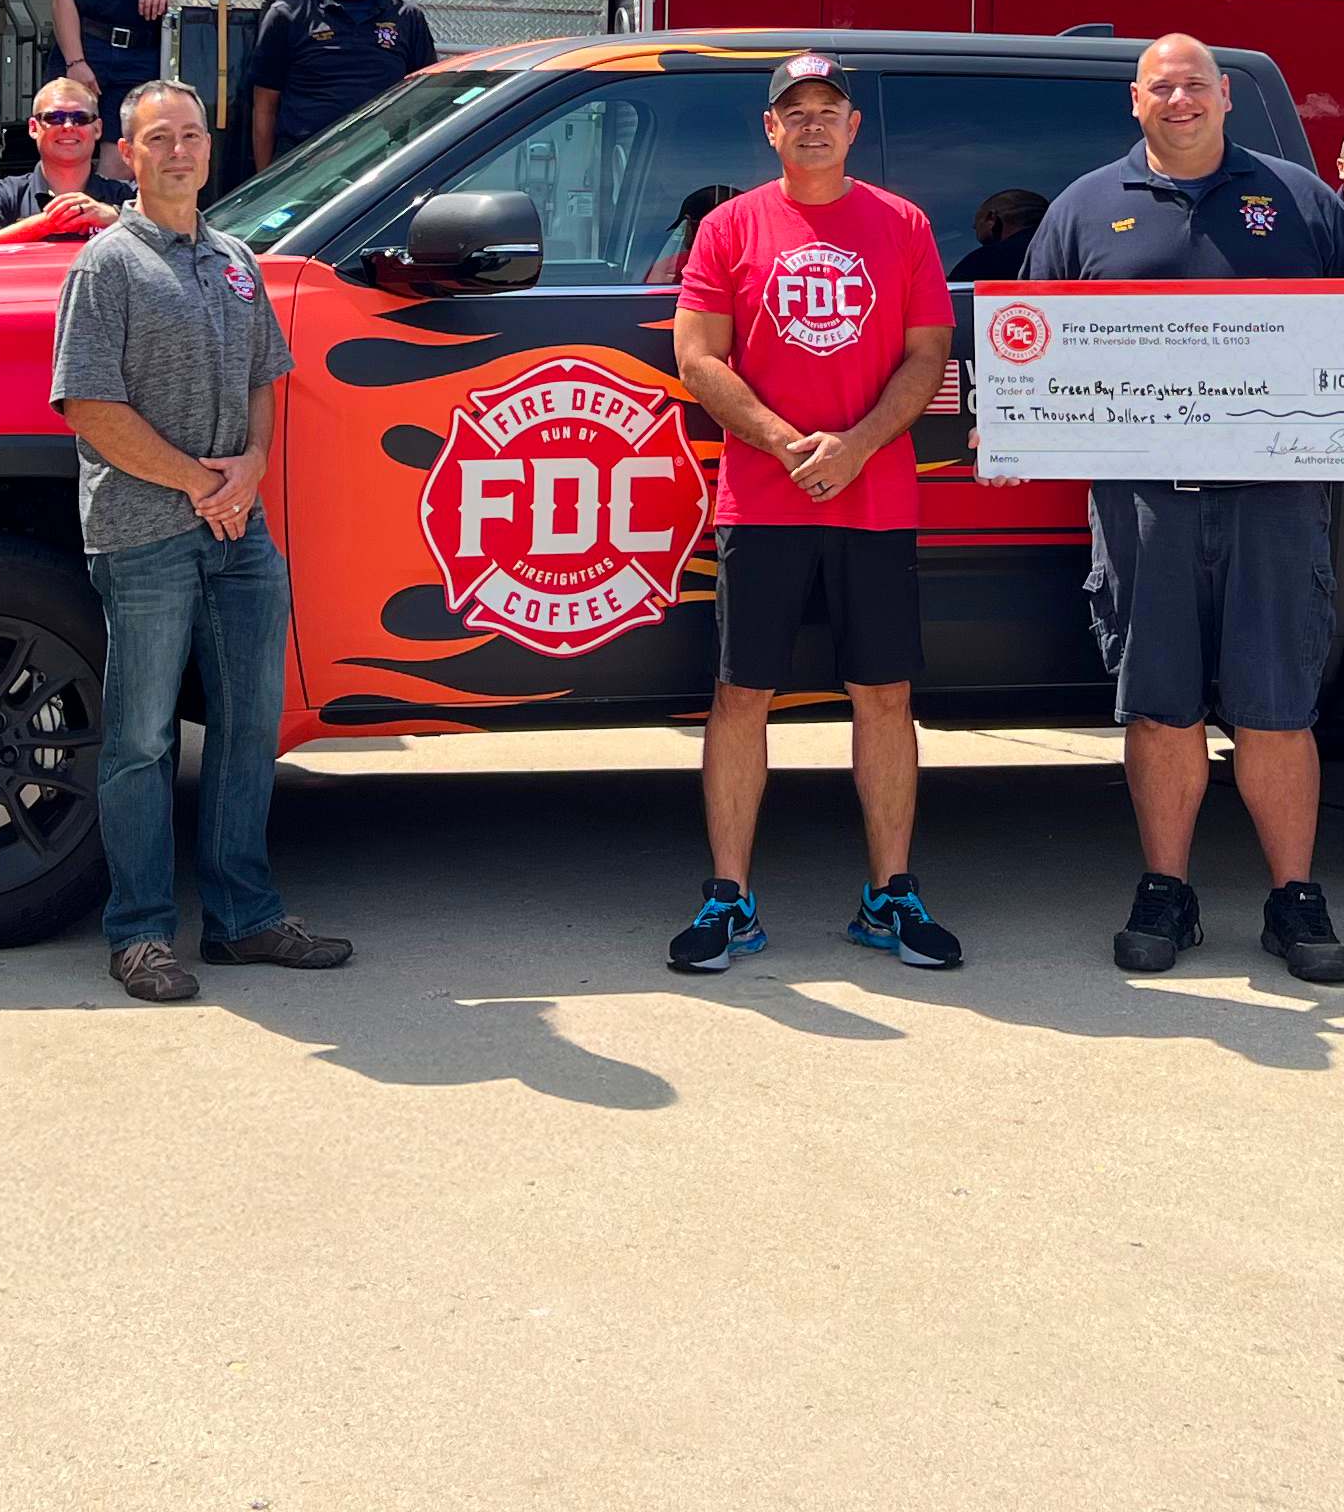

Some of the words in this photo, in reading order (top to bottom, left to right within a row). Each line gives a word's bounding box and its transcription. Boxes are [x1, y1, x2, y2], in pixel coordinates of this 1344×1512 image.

[777, 275, 863, 317] FDC
[798, 329, 845, 345] COFFEE
[1062, 323, 1086, 333] Fire
[1090, 323, 1164, 335] Department
[1167, 322, 1209, 333] Coffee
[1213, 322, 1285, 333] Foundation
[1093, 336, 1136, 345] Riverside
[1212, 337, 1220, 345] IL
[988, 375, 1005, 385] Pay
[1008, 375, 1017, 383] to
[1019, 375, 1034, 383] the
[1049, 377, 1091, 395] Green
[1094, 381, 1114, 399] Bay
[1121, 382, 1193, 400] Firefighters
[996, 387, 1023, 396] Order
[1025, 387, 1035, 396] of
[492, 389, 556, 435] FIRE
[571, 388, 640, 434] DEPT.
[996, 406, 1025, 421] Ten
[1030, 406, 1095, 422] Thousand
[1106, 407, 1155, 424] Dollars
[540, 426, 571, 443] RUN
[578, 427, 598, 444] BY
[989, 454, 1019, 463] Memo
[454, 456, 676, 557] FDC
[512, 556, 615, 586] FIREFIGHTERS
[502, 587, 623, 627] COFFEE
